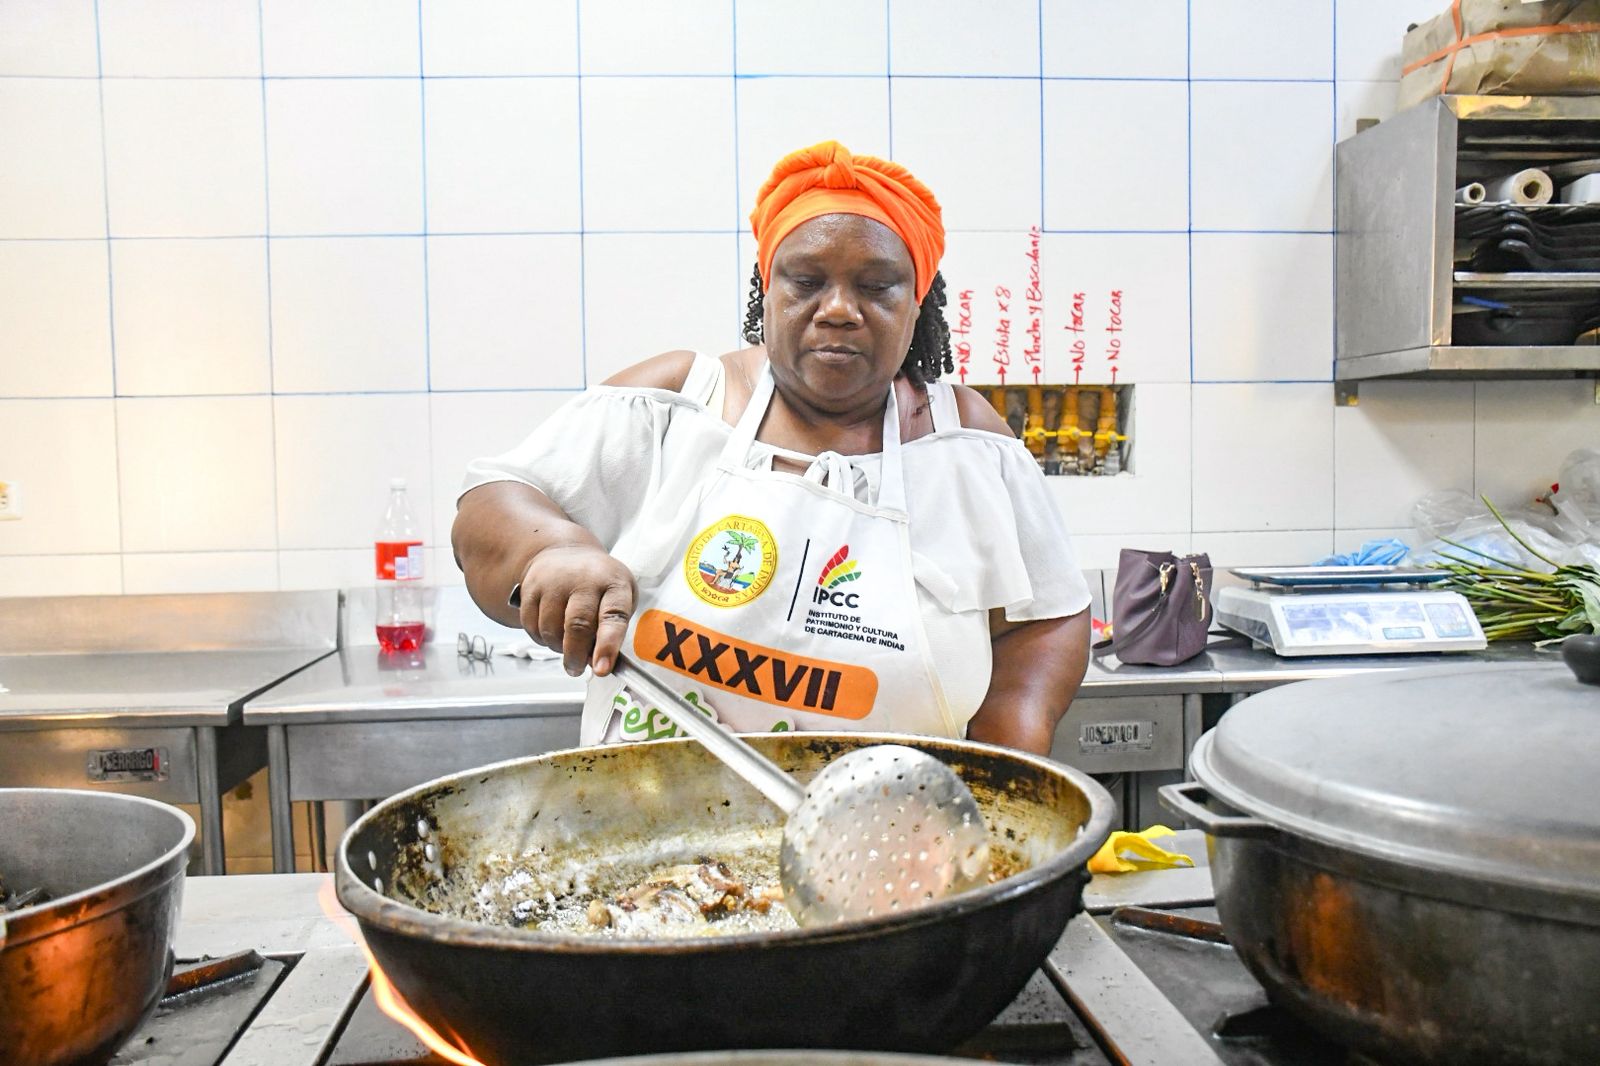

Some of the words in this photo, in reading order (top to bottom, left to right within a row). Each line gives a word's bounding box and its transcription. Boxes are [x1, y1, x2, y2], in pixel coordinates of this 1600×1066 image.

[812, 586, 860, 609] IPCC
[808, 609, 849, 622] INSTITUTO
[850, 615, 861, 624] DE
[805, 626, 816, 634] DE
[817, 628, 865, 642] CARTAGENA
[866, 636, 877, 645] DE
[878, 638, 905, 651] INDIAS
[806, 618, 854, 631] PATRIMONIO
[862, 626, 898, 640] CULTURA
[655, 621, 842, 711] XXXVII
